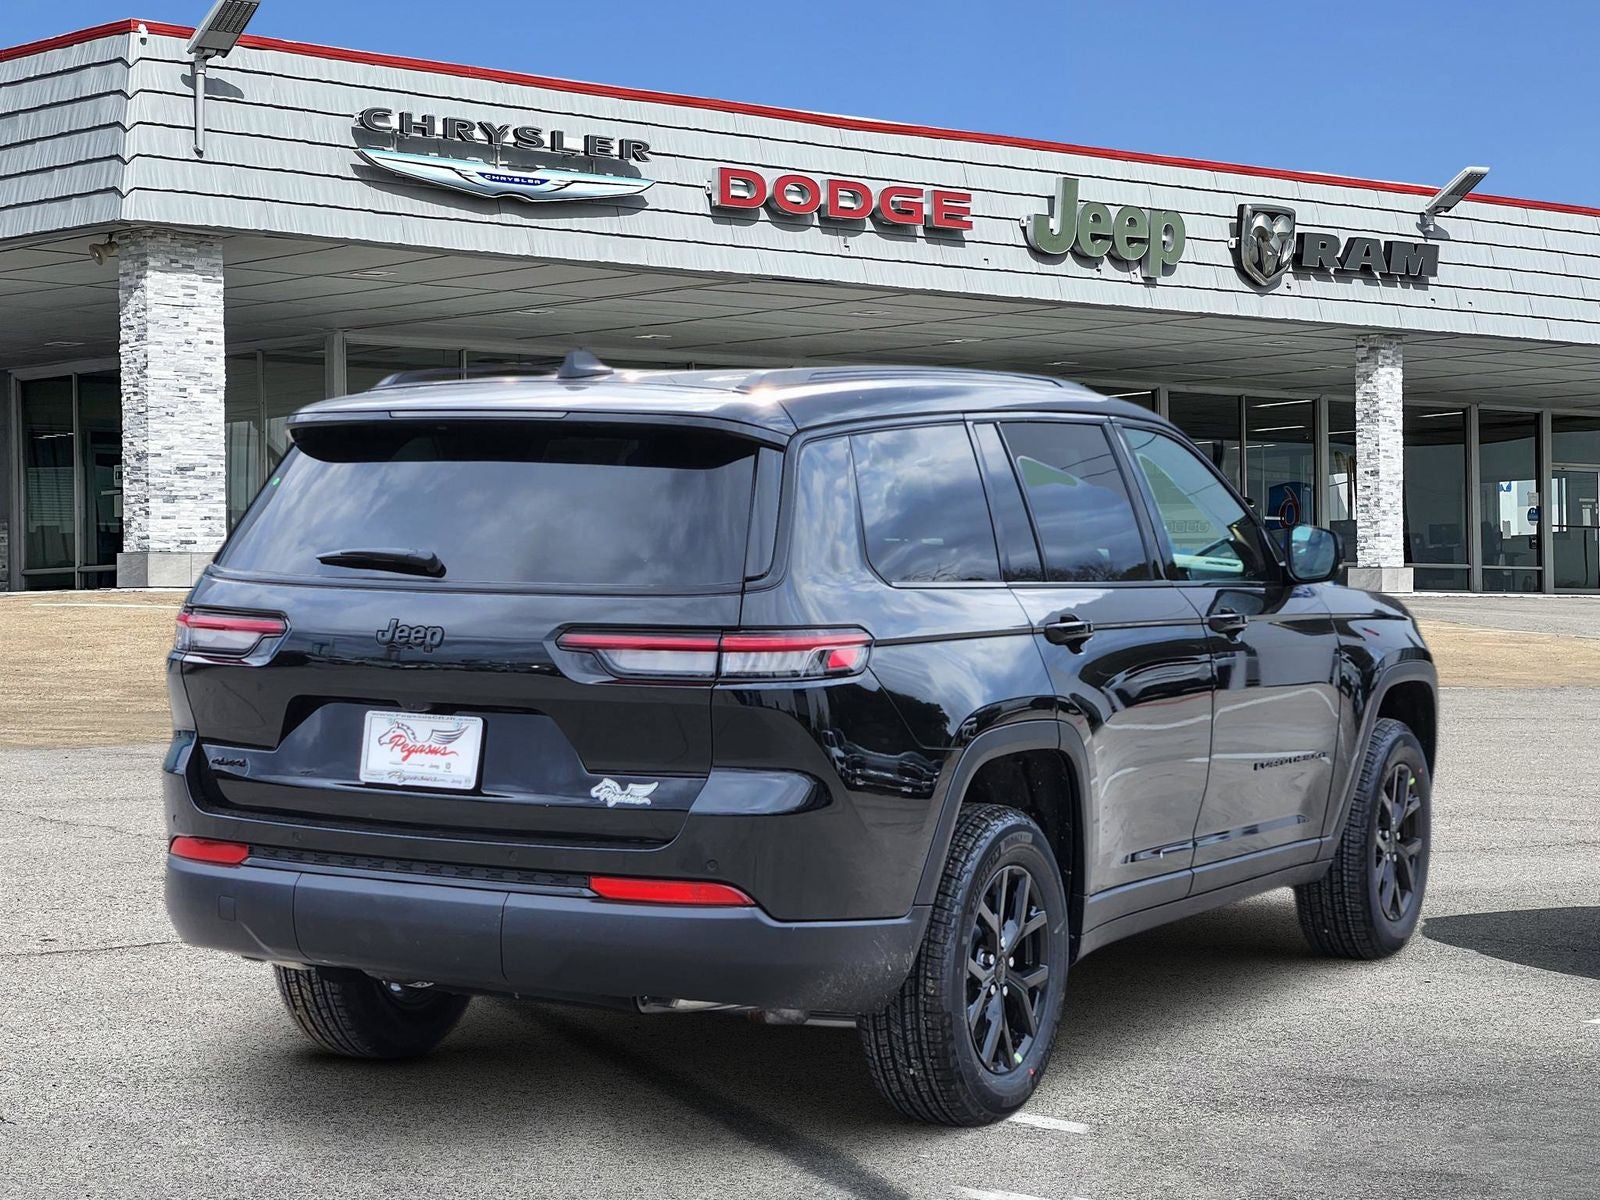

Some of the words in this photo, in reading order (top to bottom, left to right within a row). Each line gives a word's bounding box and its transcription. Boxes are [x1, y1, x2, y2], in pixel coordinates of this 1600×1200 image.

[359, 107, 651, 162] CHRYSLER
[484, 173, 541, 186] CHRYSLER
[712, 166, 973, 231] DODGE
[1026, 177, 1187, 278] Jeep
[1300, 231, 1440, 277] RAM
[376, 618, 445, 653] Jeep
[388, 734, 459, 762] Pegasus
